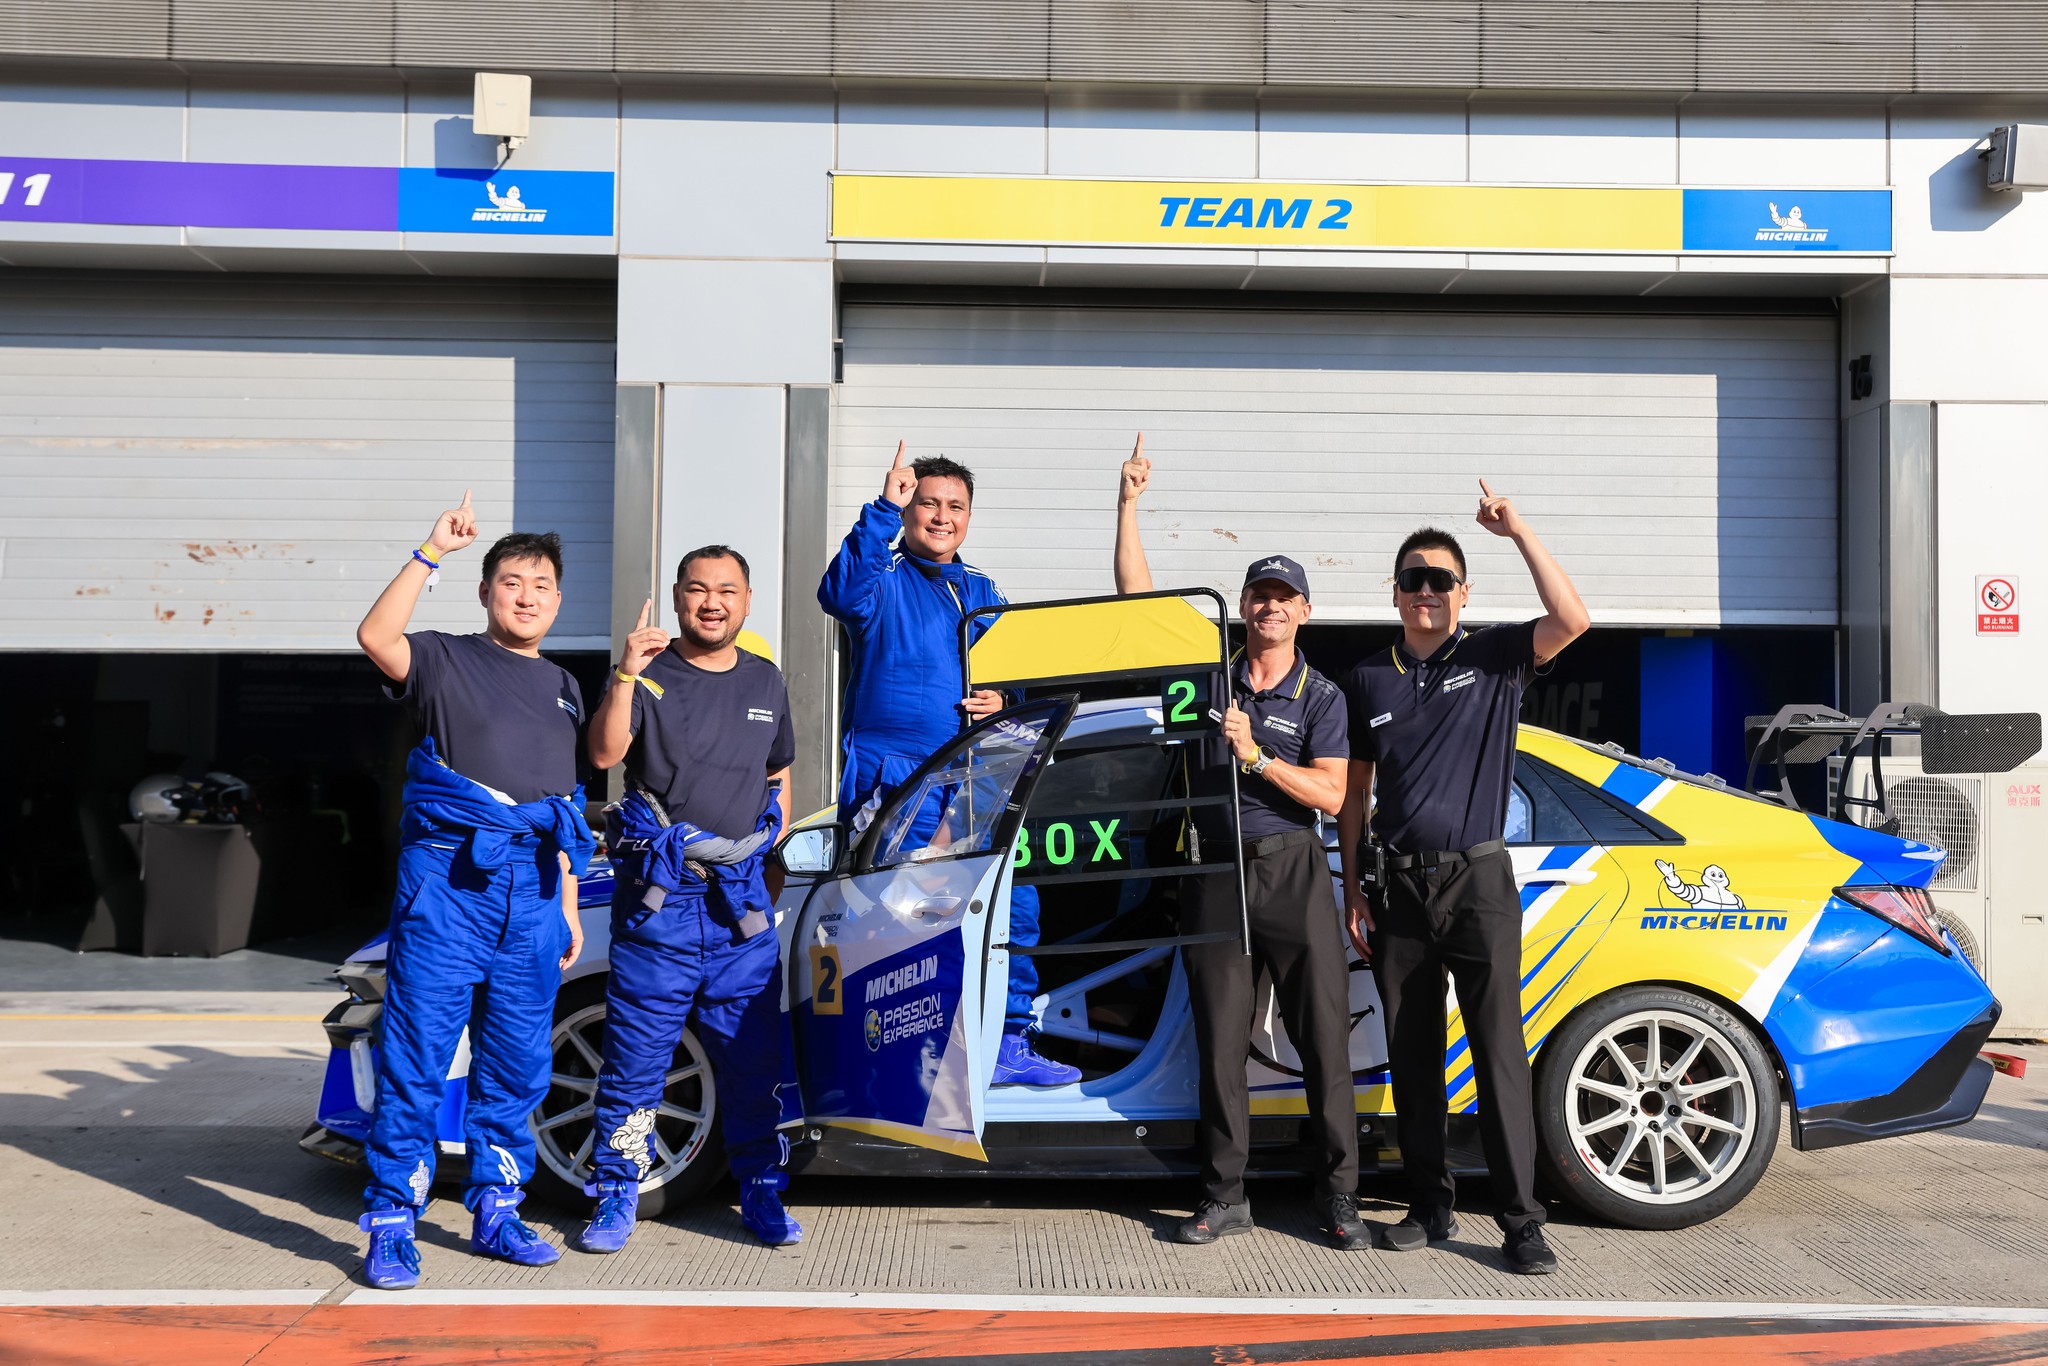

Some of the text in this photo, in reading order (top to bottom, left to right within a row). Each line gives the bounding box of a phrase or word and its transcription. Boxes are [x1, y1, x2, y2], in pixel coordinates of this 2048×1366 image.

[22, 173, 52, 206] 1
[471, 211, 546, 222] MICHELIN
[1159, 197, 1353, 230] TEAM 2
[1754, 232, 1828, 242] MICHELIN
[1167, 680, 1198, 723] 2
[2007, 785, 2041, 795] AUX
[2007, 796, 2041, 806] 奥克斯
[1640, 915, 1788, 931] MICHELIN
[817, 955, 838, 1003] 2
[865, 954, 938, 1004] MICHELIN
[883, 992, 941, 1029] PASSION
[883, 1012, 944, 1044] EXPERIENCE
